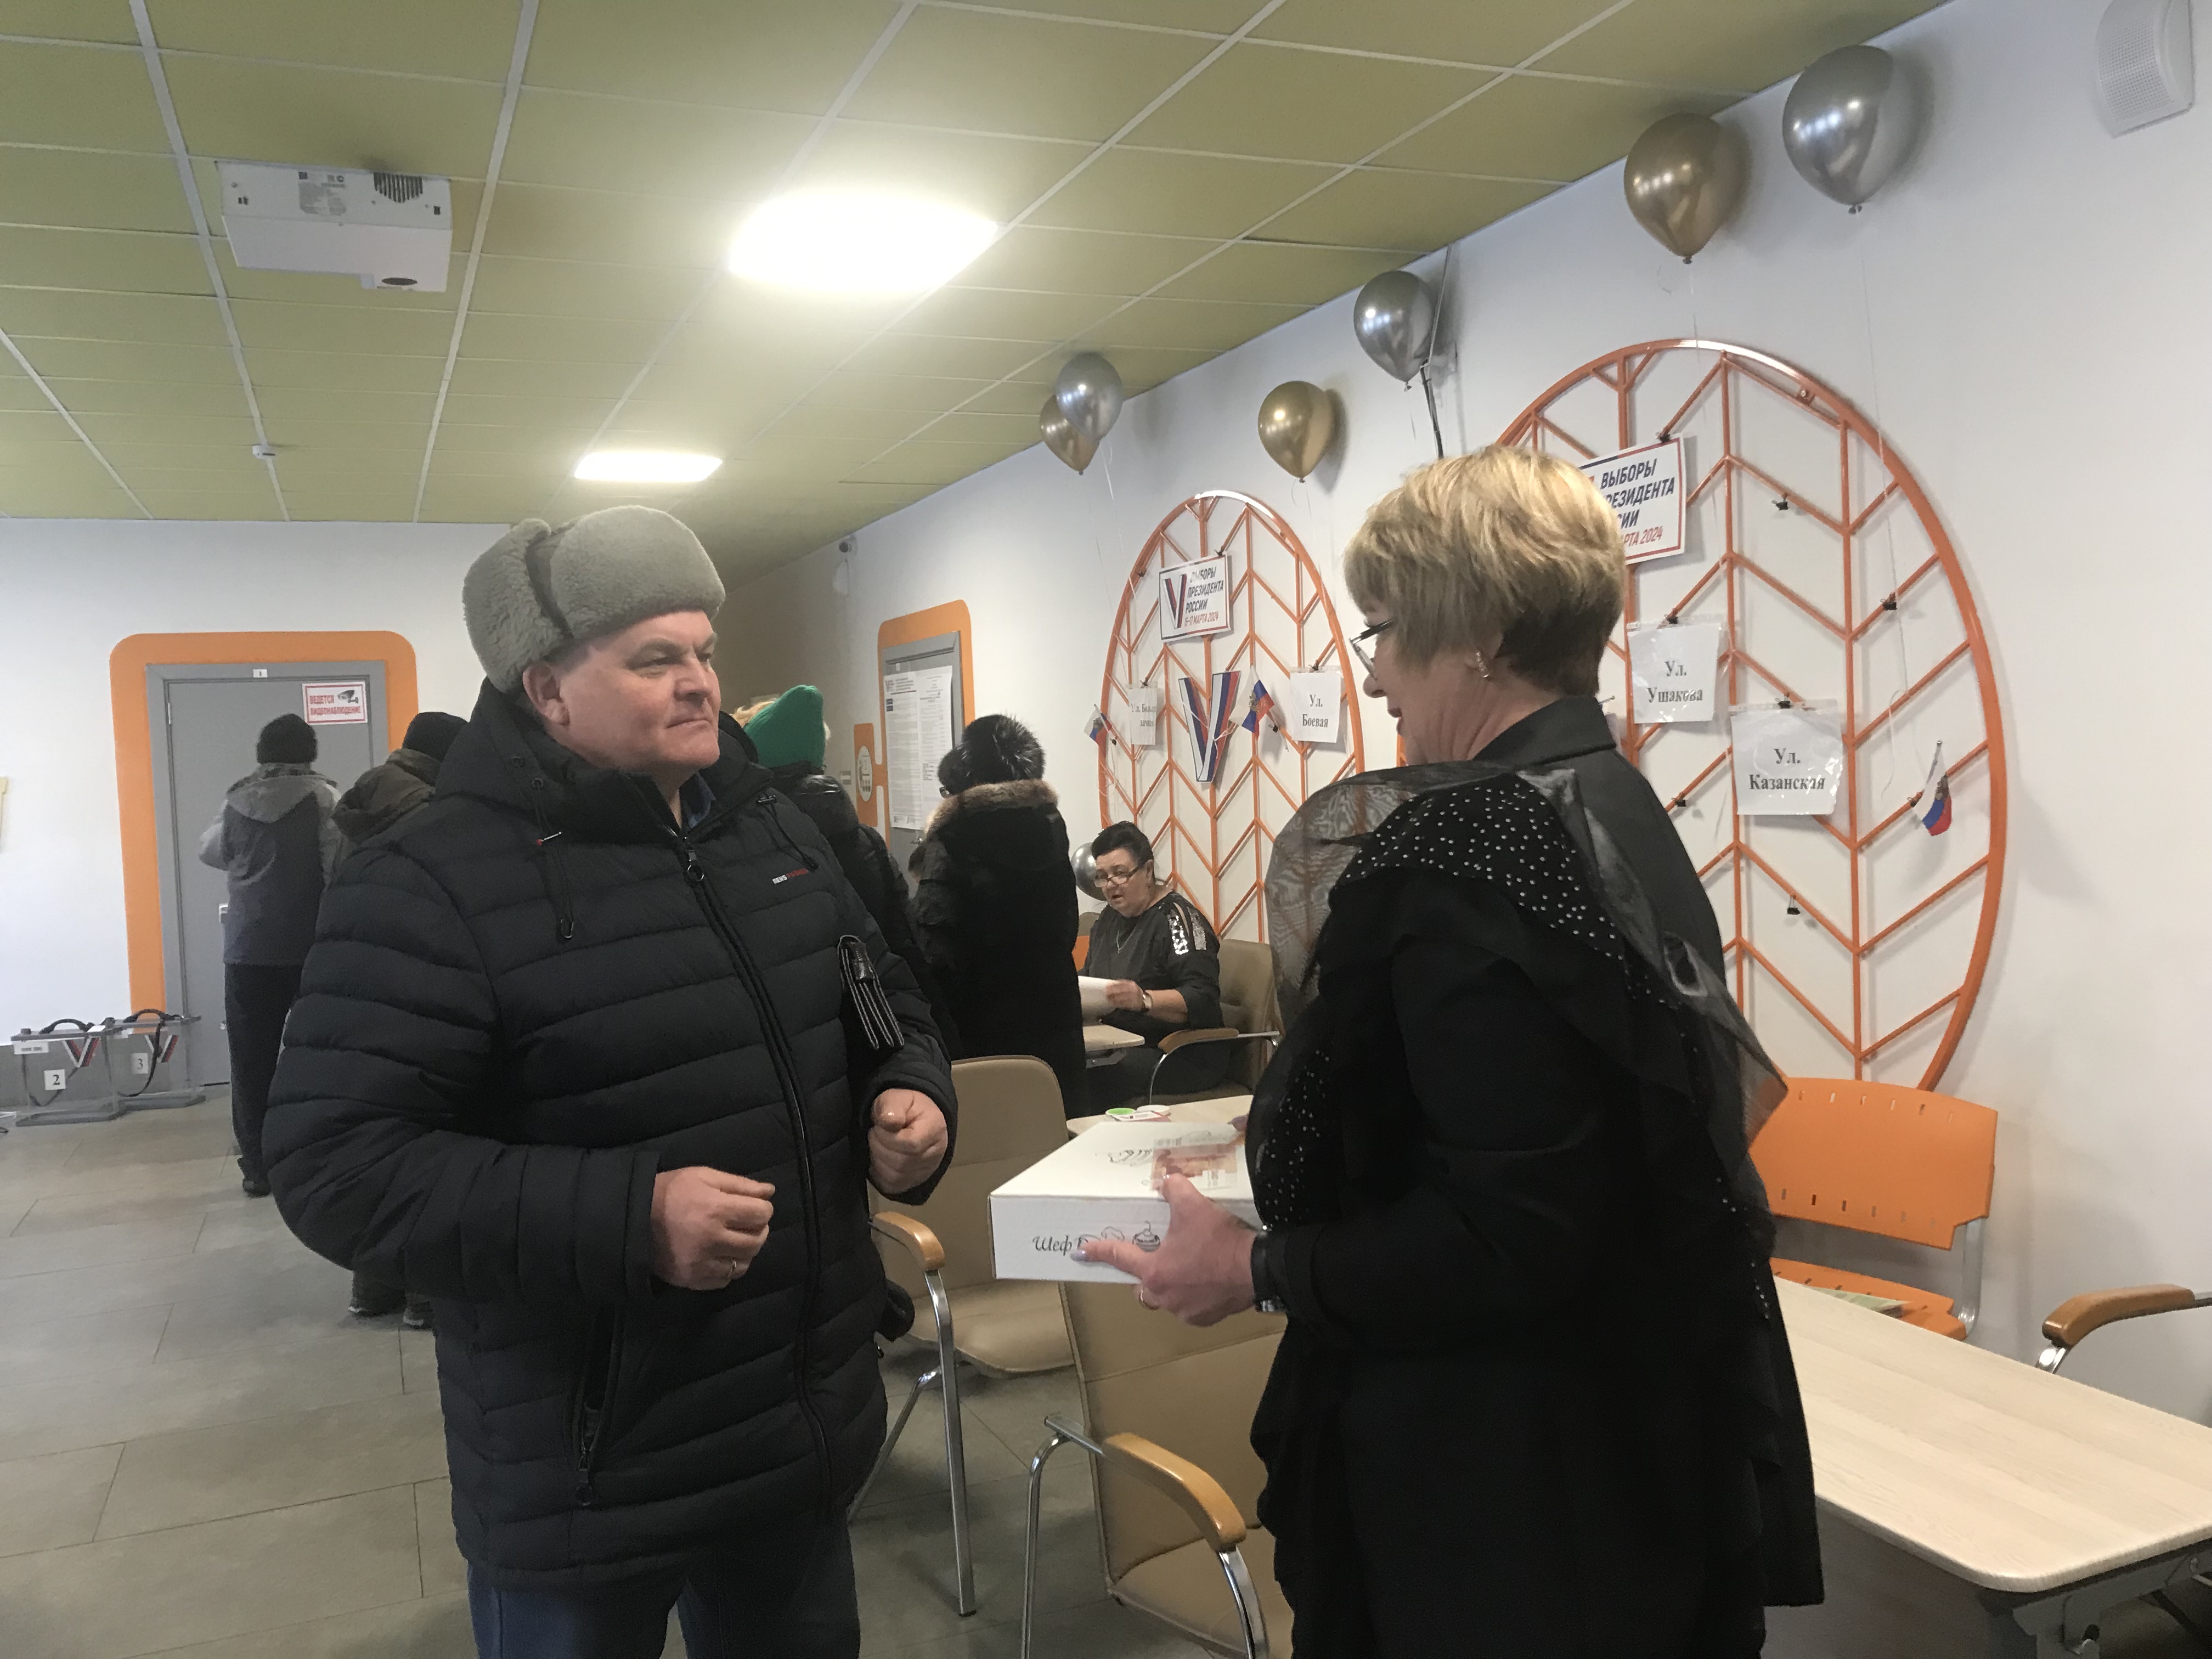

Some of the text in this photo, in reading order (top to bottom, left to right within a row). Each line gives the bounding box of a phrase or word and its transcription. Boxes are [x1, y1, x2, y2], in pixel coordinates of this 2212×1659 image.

[1600, 459, 1657, 489] ВЫБОРЫ
[1606, 477, 1675, 509] РЕЗИДЕНТА
[1623, 525, 1663, 547] РТА 2024
[1187, 580, 1224, 598] ПРЕЗИДЕНТА
[1186, 599, 1208, 613] РОССИИ
[1664, 660, 1687, 677] Ул.
[1309, 694, 1323, 708] Ул.
[1647, 687, 1703, 703] Ушакова
[1302, 713, 1329, 728] Боевая
[1773, 748, 1801, 765] Ул.
[1748, 774, 1826, 791] Казанская
[137, 1058, 144, 1069] 3
[52, 1074, 60, 1086] 2
[1032, 1234, 1073, 1256] Шеф
